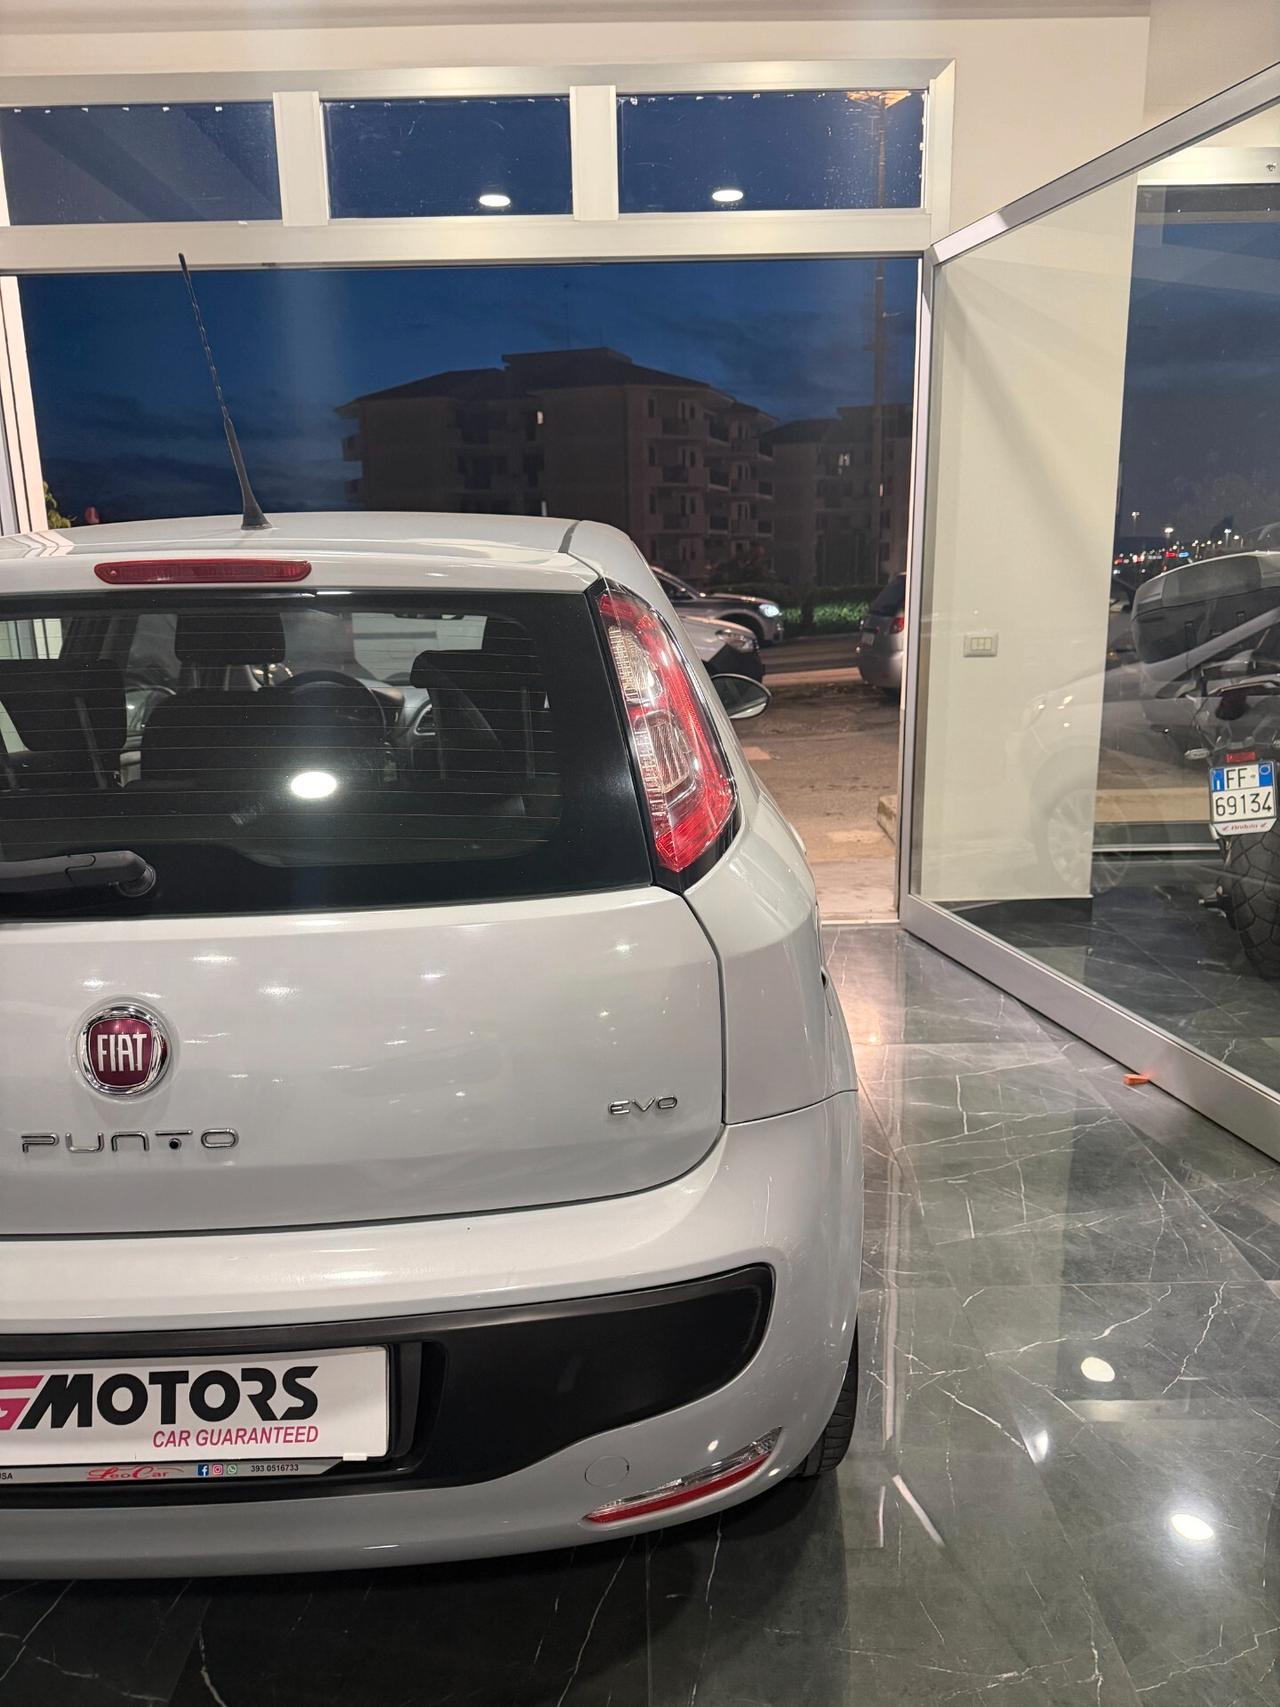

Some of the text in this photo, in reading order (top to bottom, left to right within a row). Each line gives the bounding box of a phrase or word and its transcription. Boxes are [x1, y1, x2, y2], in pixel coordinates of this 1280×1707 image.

[1226, 767, 1248, 788] FF
[1215, 791, 1272, 816] 69134
[97, 1033, 148, 1072] FIAT
[608, 1096, 678, 1115] EVO
[21, 1127, 239, 1152] PUNTO
[153, 1426, 319, 1448] CAR GUARANTEED
[0, 1472, 13, 1480] SA
[250, 1464, 299, 1473] 393 0516733
